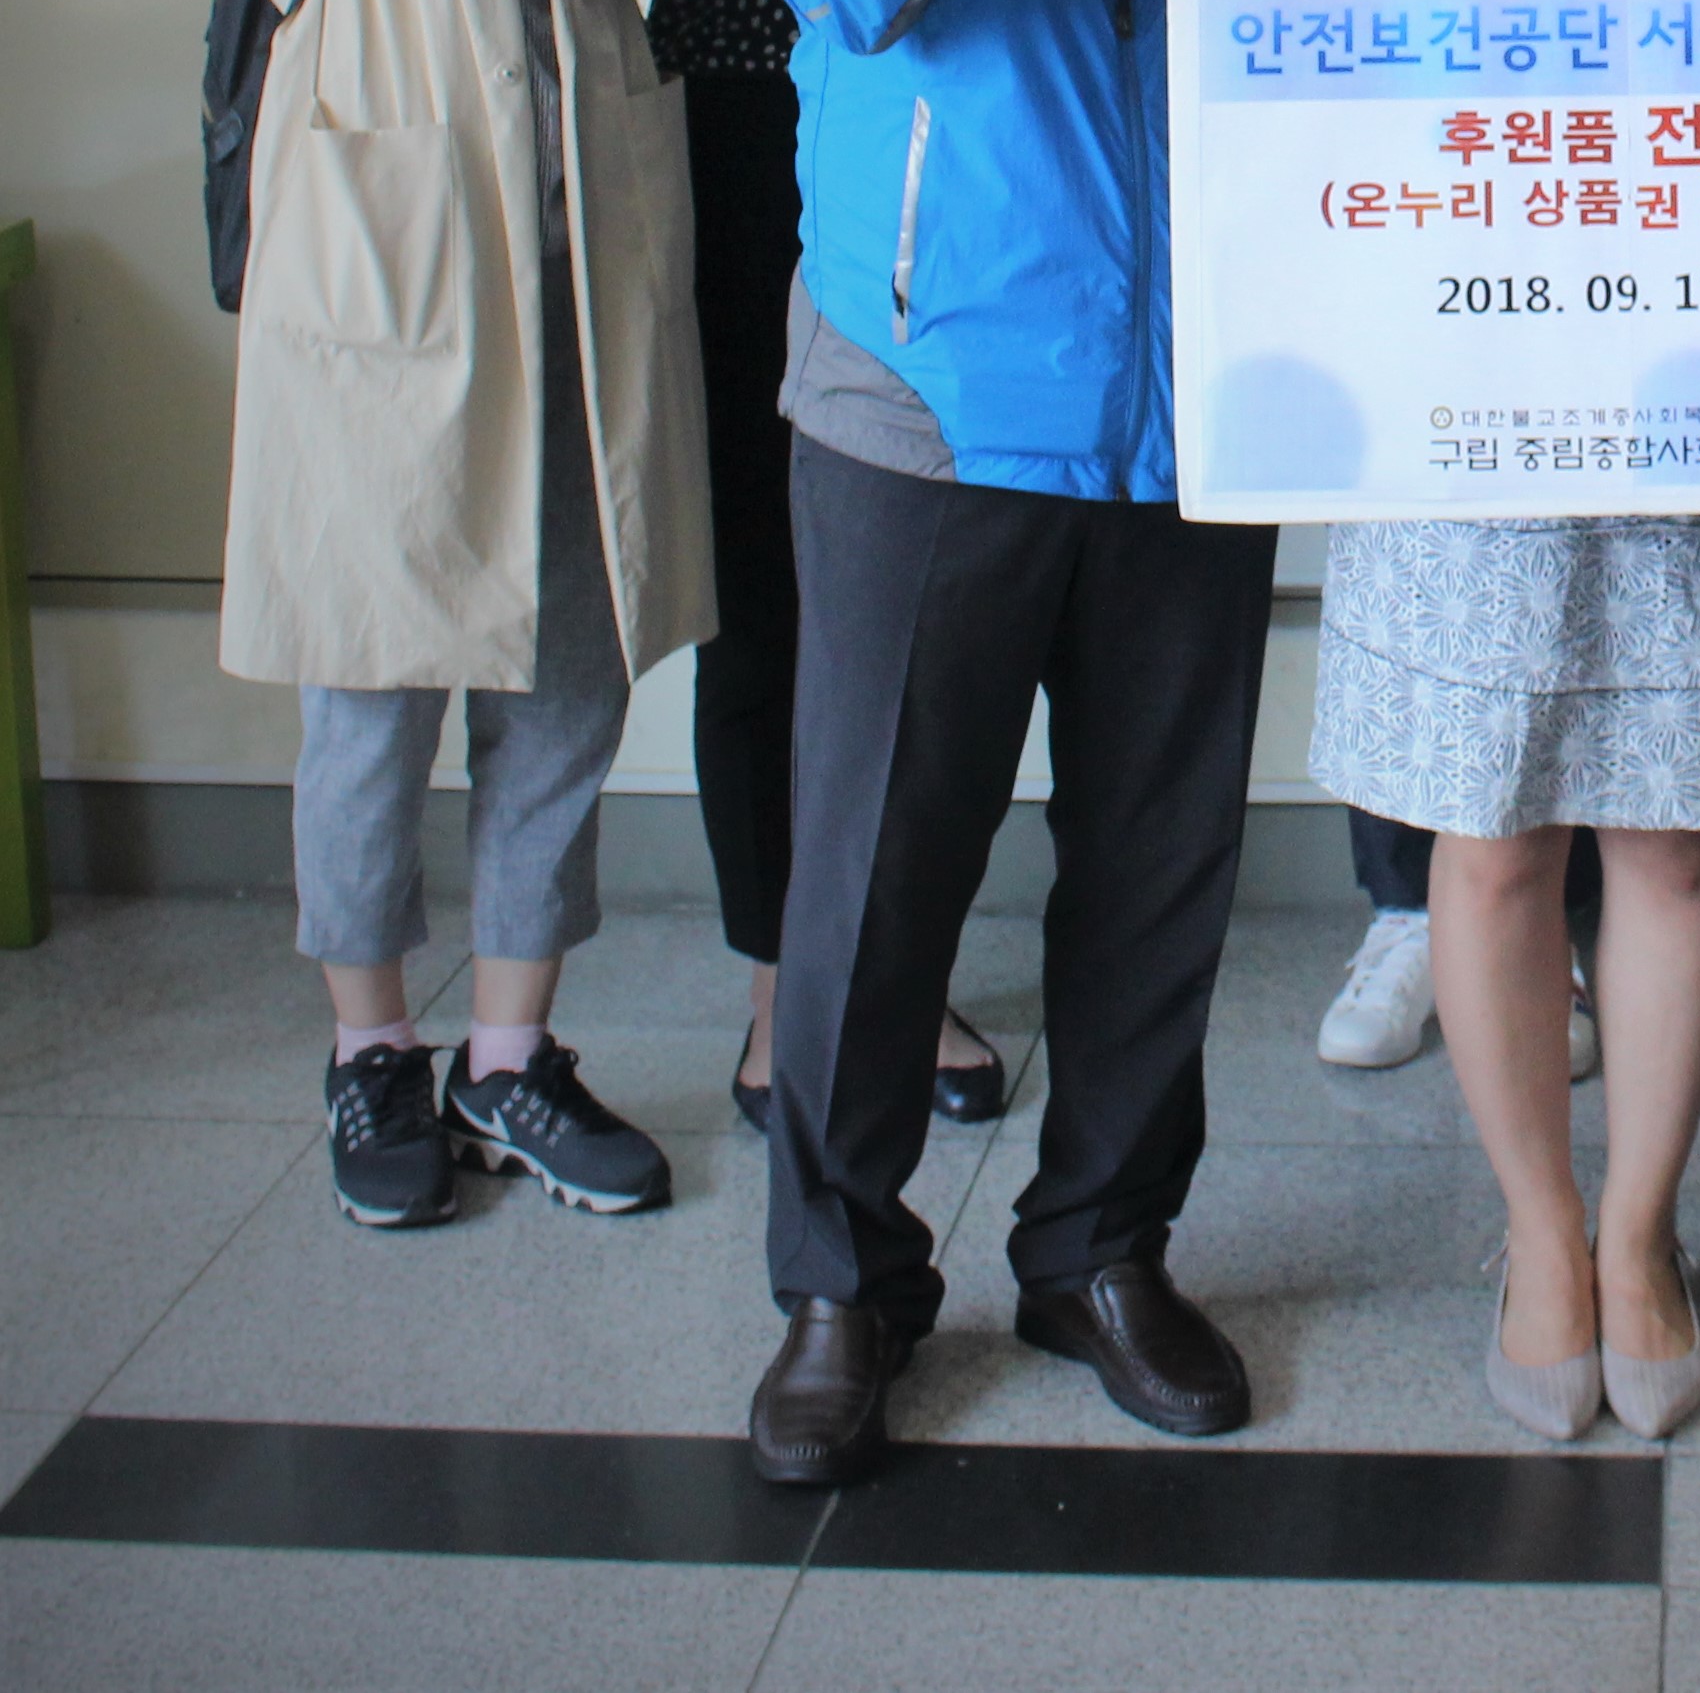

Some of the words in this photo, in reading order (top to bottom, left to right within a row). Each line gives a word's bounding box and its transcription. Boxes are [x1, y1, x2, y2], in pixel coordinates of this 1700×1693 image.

[1231, 4, 1618, 76] 안전보건공단
[1439, 109, 1618, 167] 후원품
[1320, 179, 1494, 229] (온누리
[1523, 178, 1679, 231] 상품권
[1436, 275, 1565, 315] 2018.
[1585, 273, 1652, 314] 09.
[1429, 437, 1499, 472] 구립
